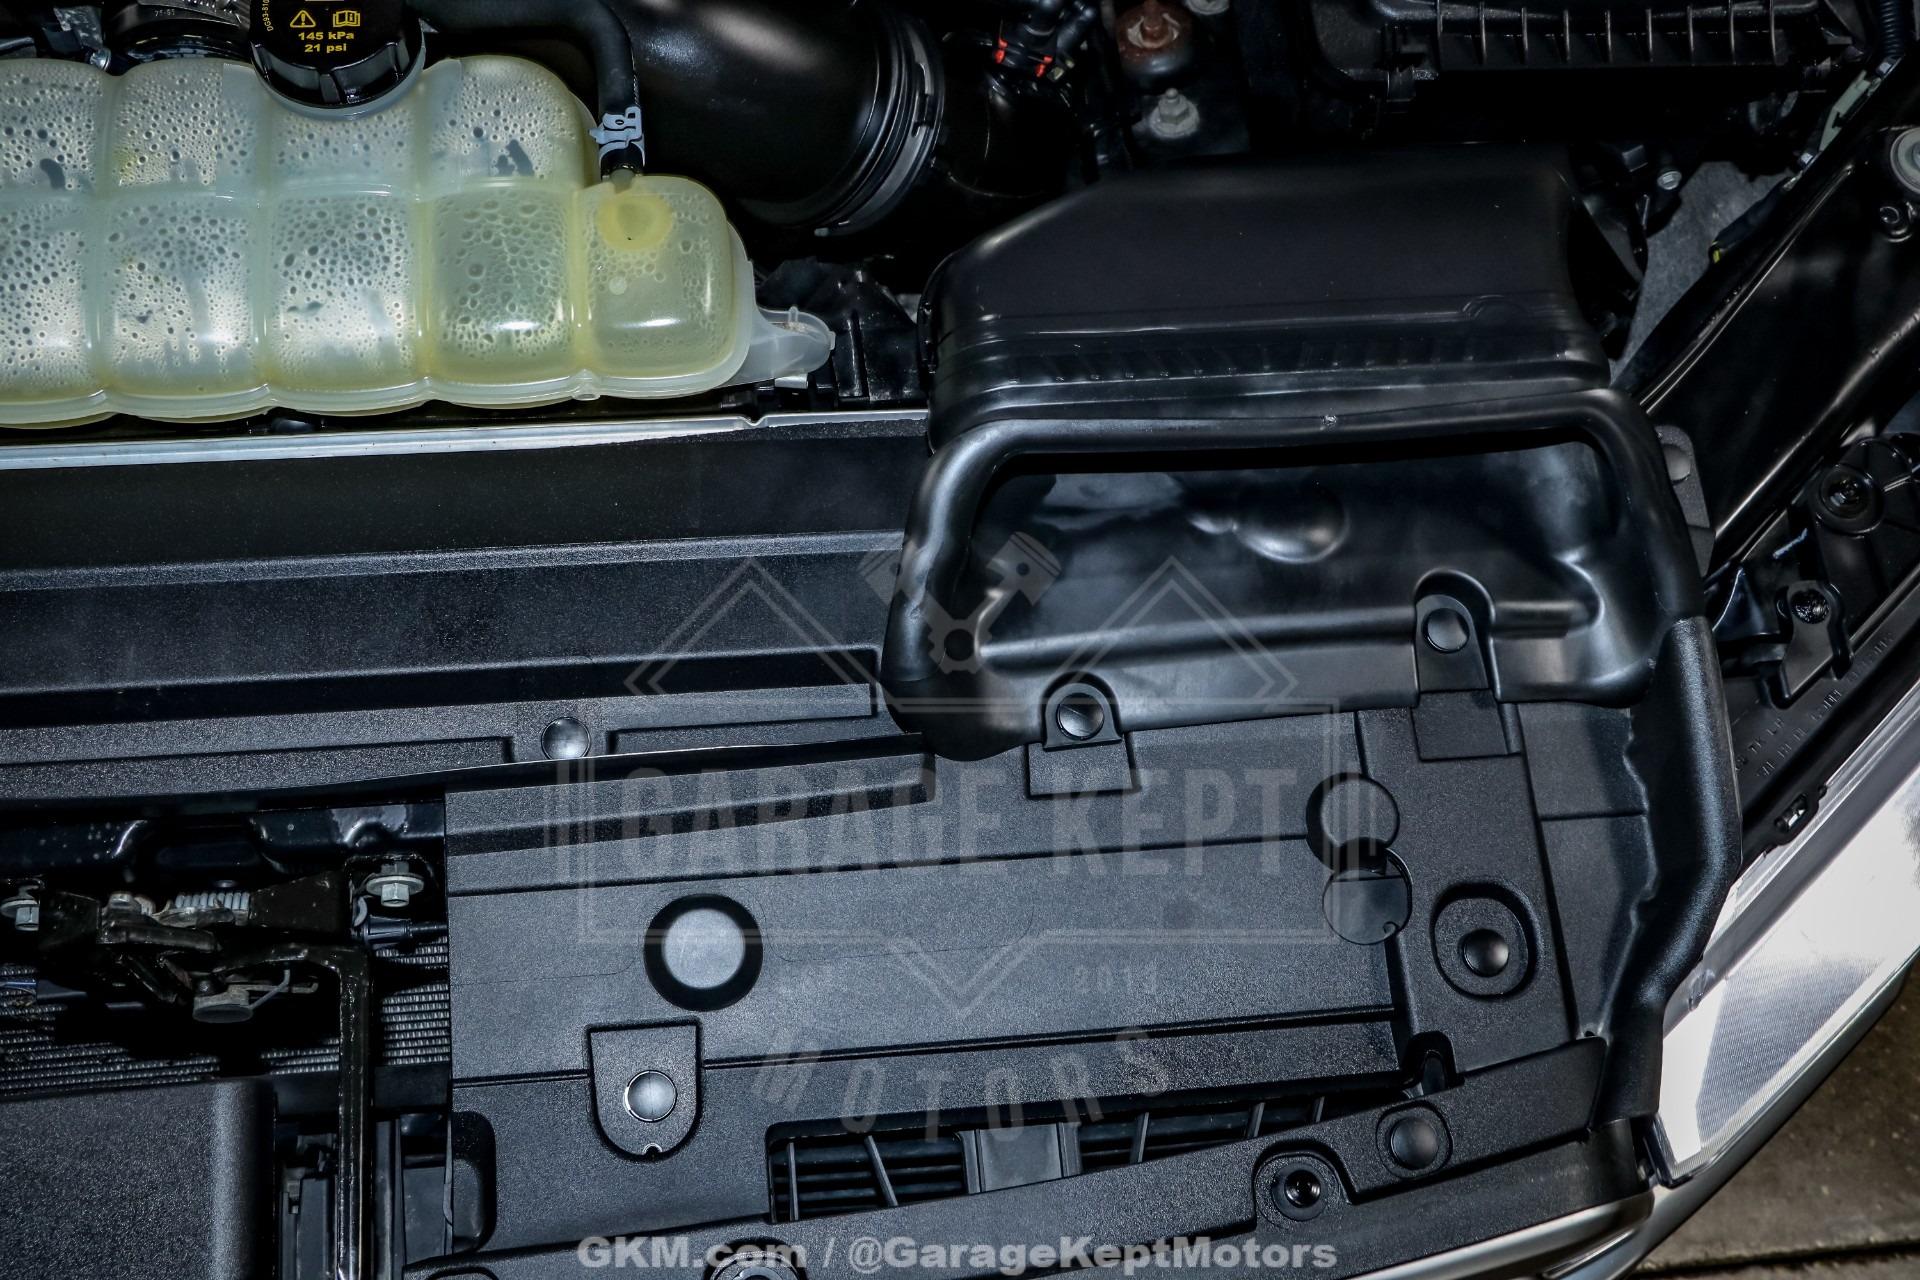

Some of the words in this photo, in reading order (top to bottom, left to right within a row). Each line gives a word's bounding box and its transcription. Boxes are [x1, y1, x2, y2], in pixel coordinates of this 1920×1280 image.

[298, 32, 324, 40] 145
[328, 32, 355, 40] kPa
[304, 43, 321, 53] 21
[326, 43, 347, 53] psi
